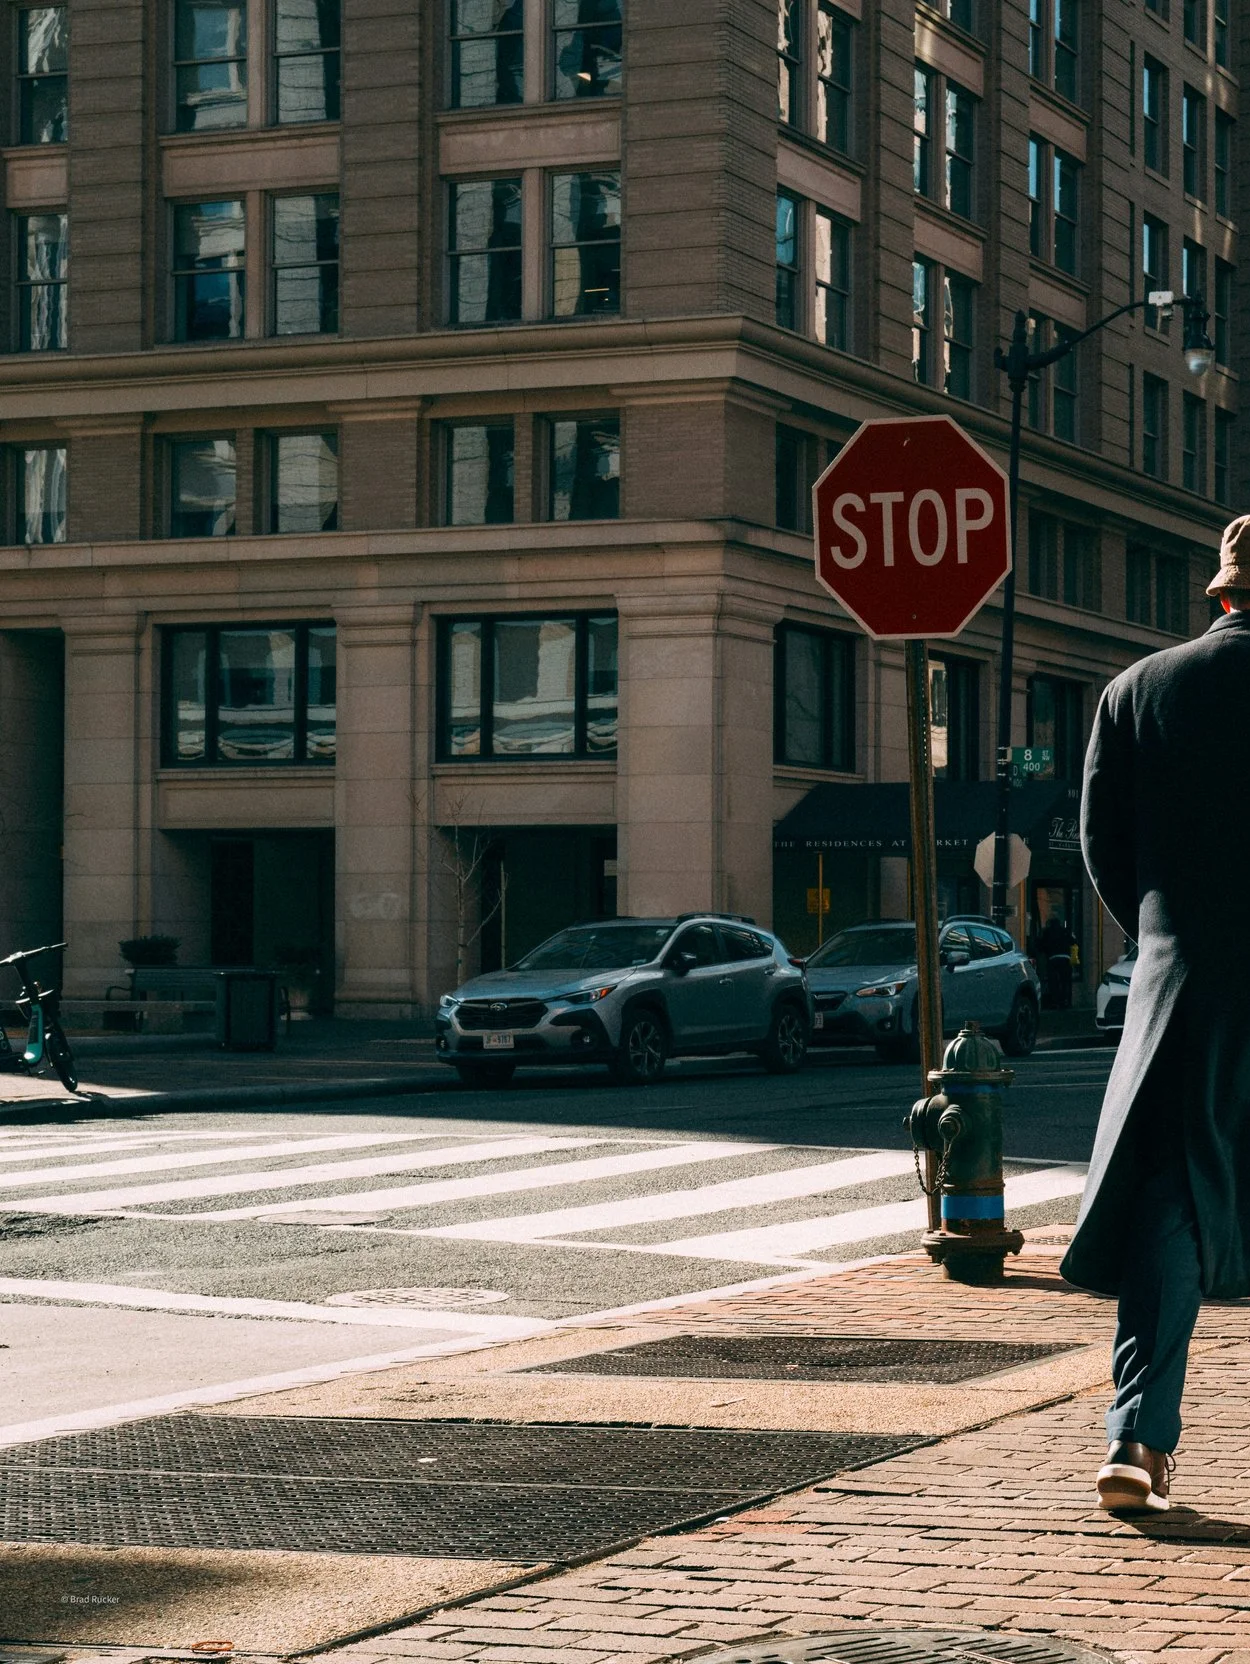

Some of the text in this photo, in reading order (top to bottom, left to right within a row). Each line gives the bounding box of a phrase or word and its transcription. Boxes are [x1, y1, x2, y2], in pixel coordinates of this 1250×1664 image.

[830, 487, 995, 570] STOP
[1024, 748, 1033, 761] 8
[1023, 762, 1040, 772] 400
[805, 840, 882, 848] RESIDENCES
[892, 839, 907, 847] AT
[936, 839, 969, 847] RKET
